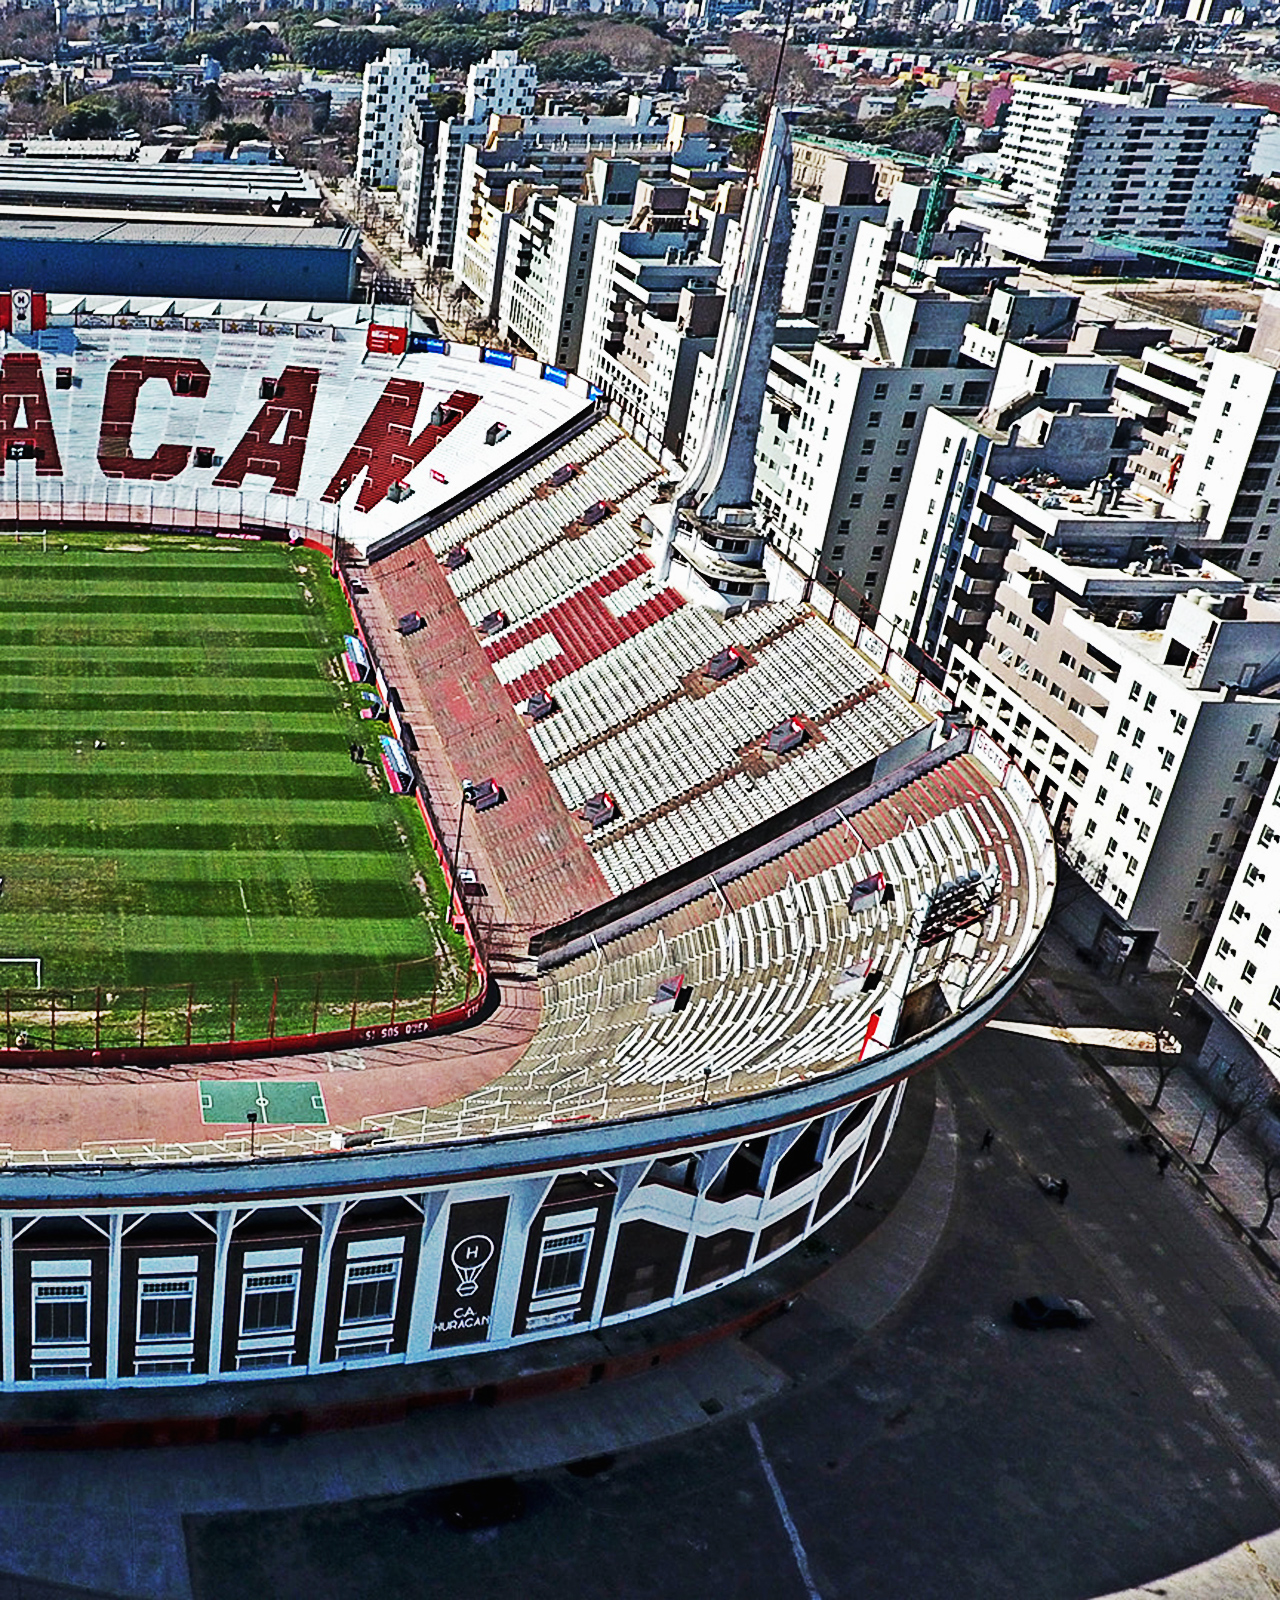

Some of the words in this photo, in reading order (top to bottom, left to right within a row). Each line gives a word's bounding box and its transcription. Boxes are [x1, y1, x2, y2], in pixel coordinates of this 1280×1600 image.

[381, 1026, 399, 1038] SOS
[466, 1246, 479, 1260] H
[433, 1315, 493, 1333] HURACAN
